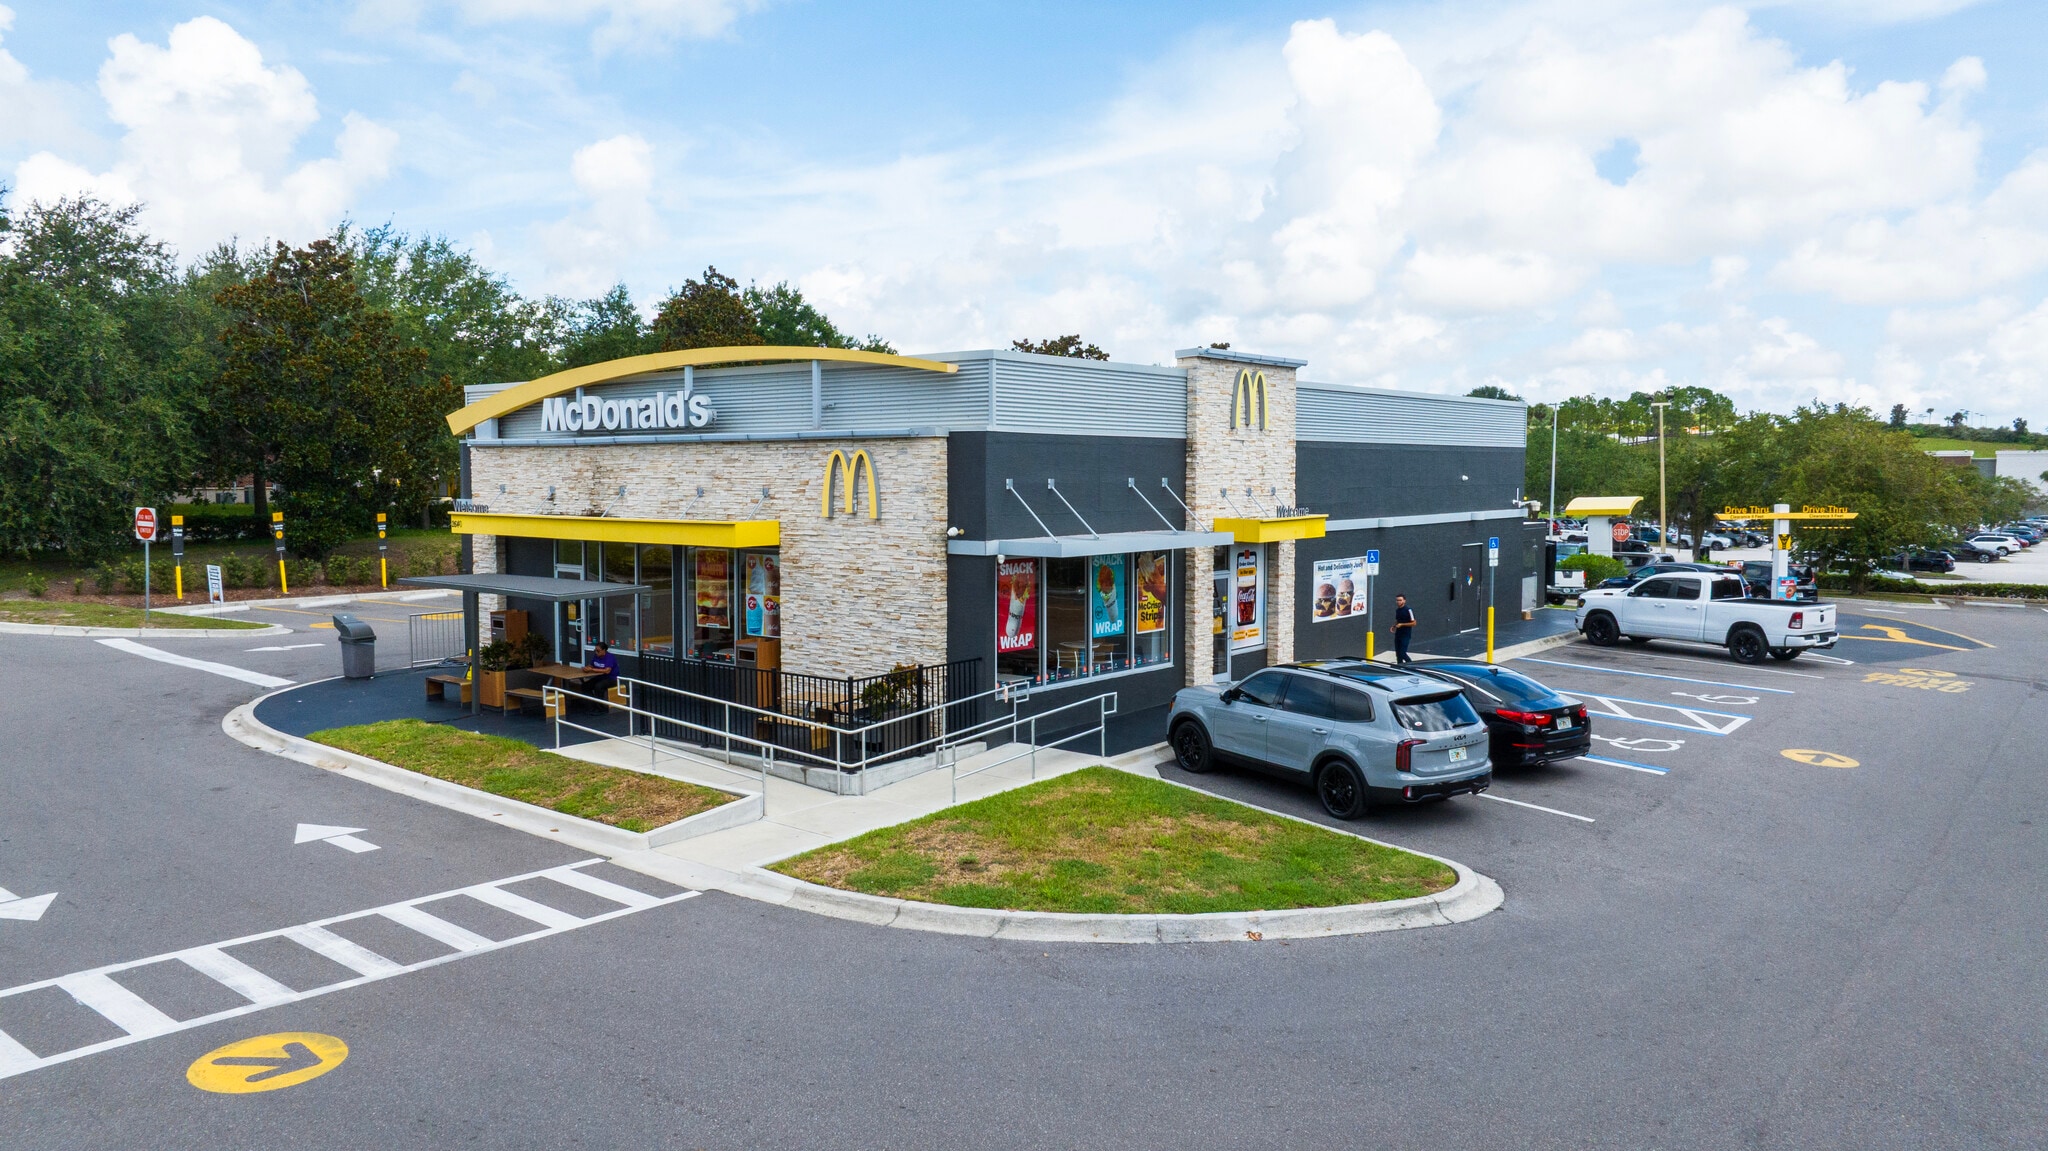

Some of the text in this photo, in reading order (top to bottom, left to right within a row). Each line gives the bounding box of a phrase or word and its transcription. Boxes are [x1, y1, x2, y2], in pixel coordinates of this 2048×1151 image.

[541, 391, 711, 431] McDonald's
[453, 499, 489, 513] Welcome
[1276, 505, 1310, 518] Welcome
[1725, 505, 1769, 514] Drive Thru
[1803, 505, 1848, 513] Drive Thru
[1613, 528, 1629, 536] STOP
[1093, 553, 1123, 567] SNACK
[1334, 562, 1353, 570] Deliciously
[1000, 562, 1034, 576] SNACK
[1138, 601, 1163, 610] McCrisp
[1095, 619, 1123, 635] WRAP
[1000, 633, 1033, 649] WRAP
